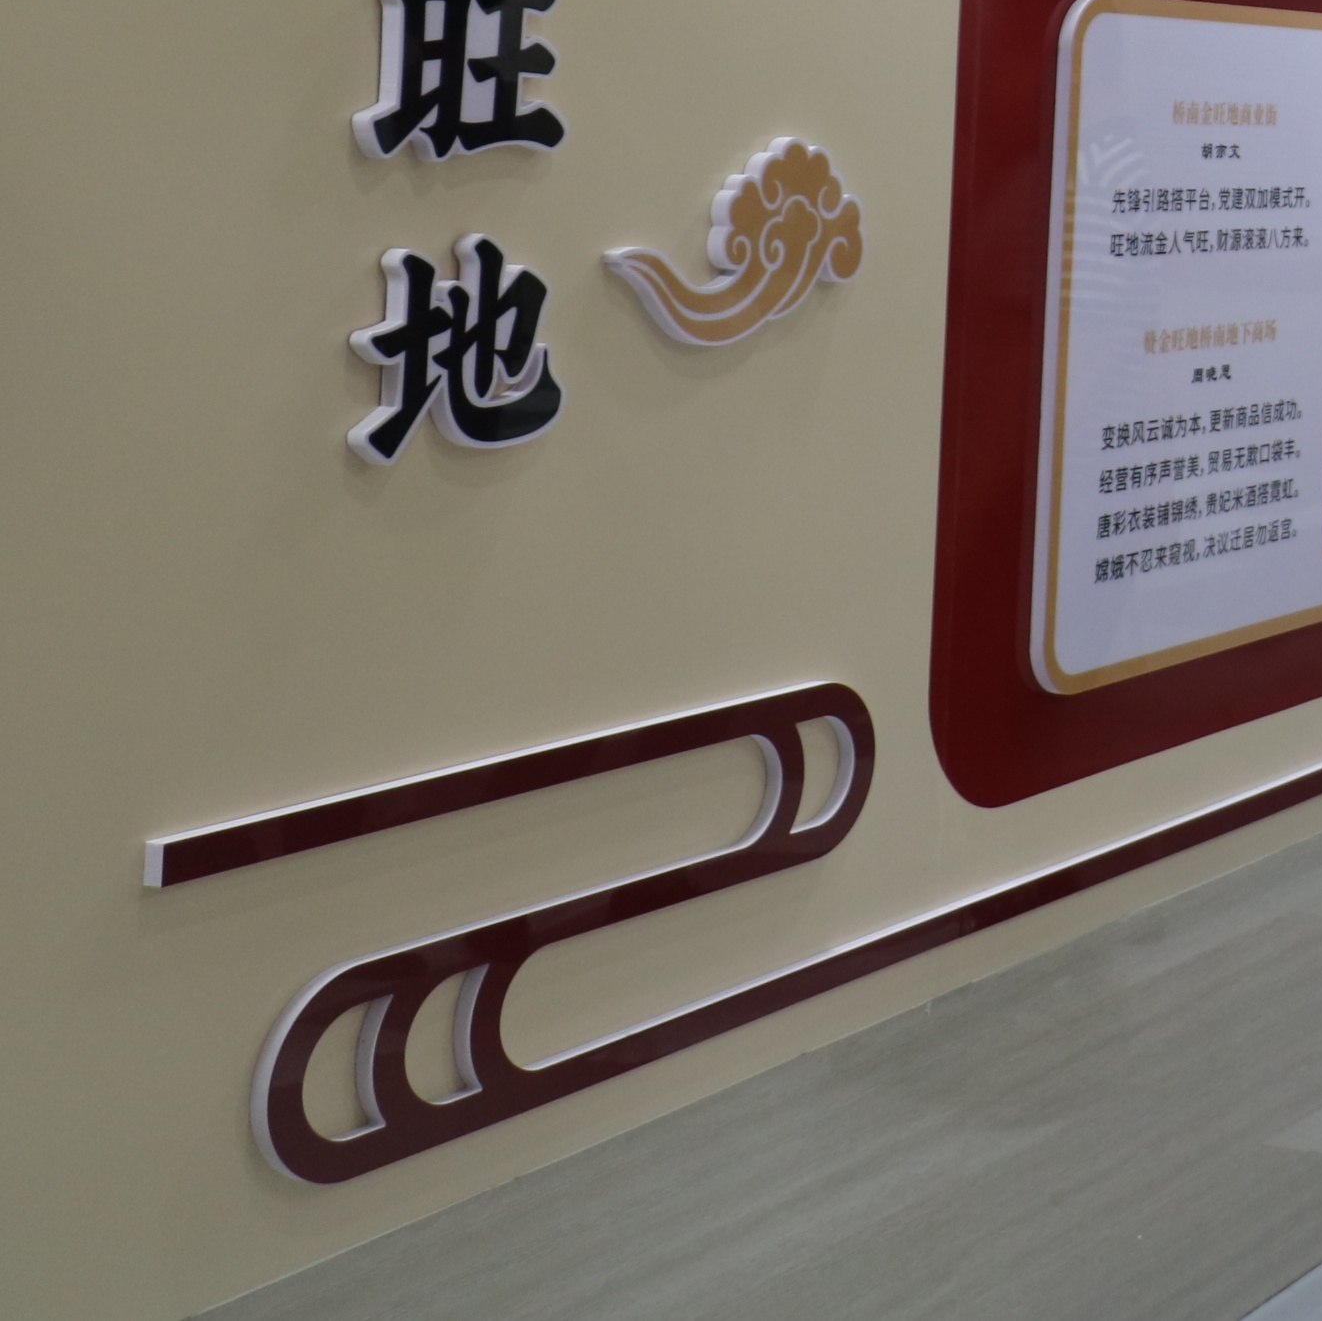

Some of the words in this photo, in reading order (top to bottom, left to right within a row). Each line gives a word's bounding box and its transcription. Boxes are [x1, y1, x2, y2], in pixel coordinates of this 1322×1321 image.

[1171, 99, 1279, 127] 桥南金旺地商业街
[1110, 185, 1312, 215] 先锋引路搭平台，党建双加模式开。
[1109, 225, 1310, 258] 旺地流金人气旺，财源滚滚八方来。
[1100, 397, 1303, 452] 变换风云诚为本，更新商品信成功。
[1098, 437, 1301, 496] 经营有序声誉美，贸易无欺口袋丰。
[1095, 477, 1300, 542] 唐彩衣装铺锦绣，贵妃米酒搭霓虹。
